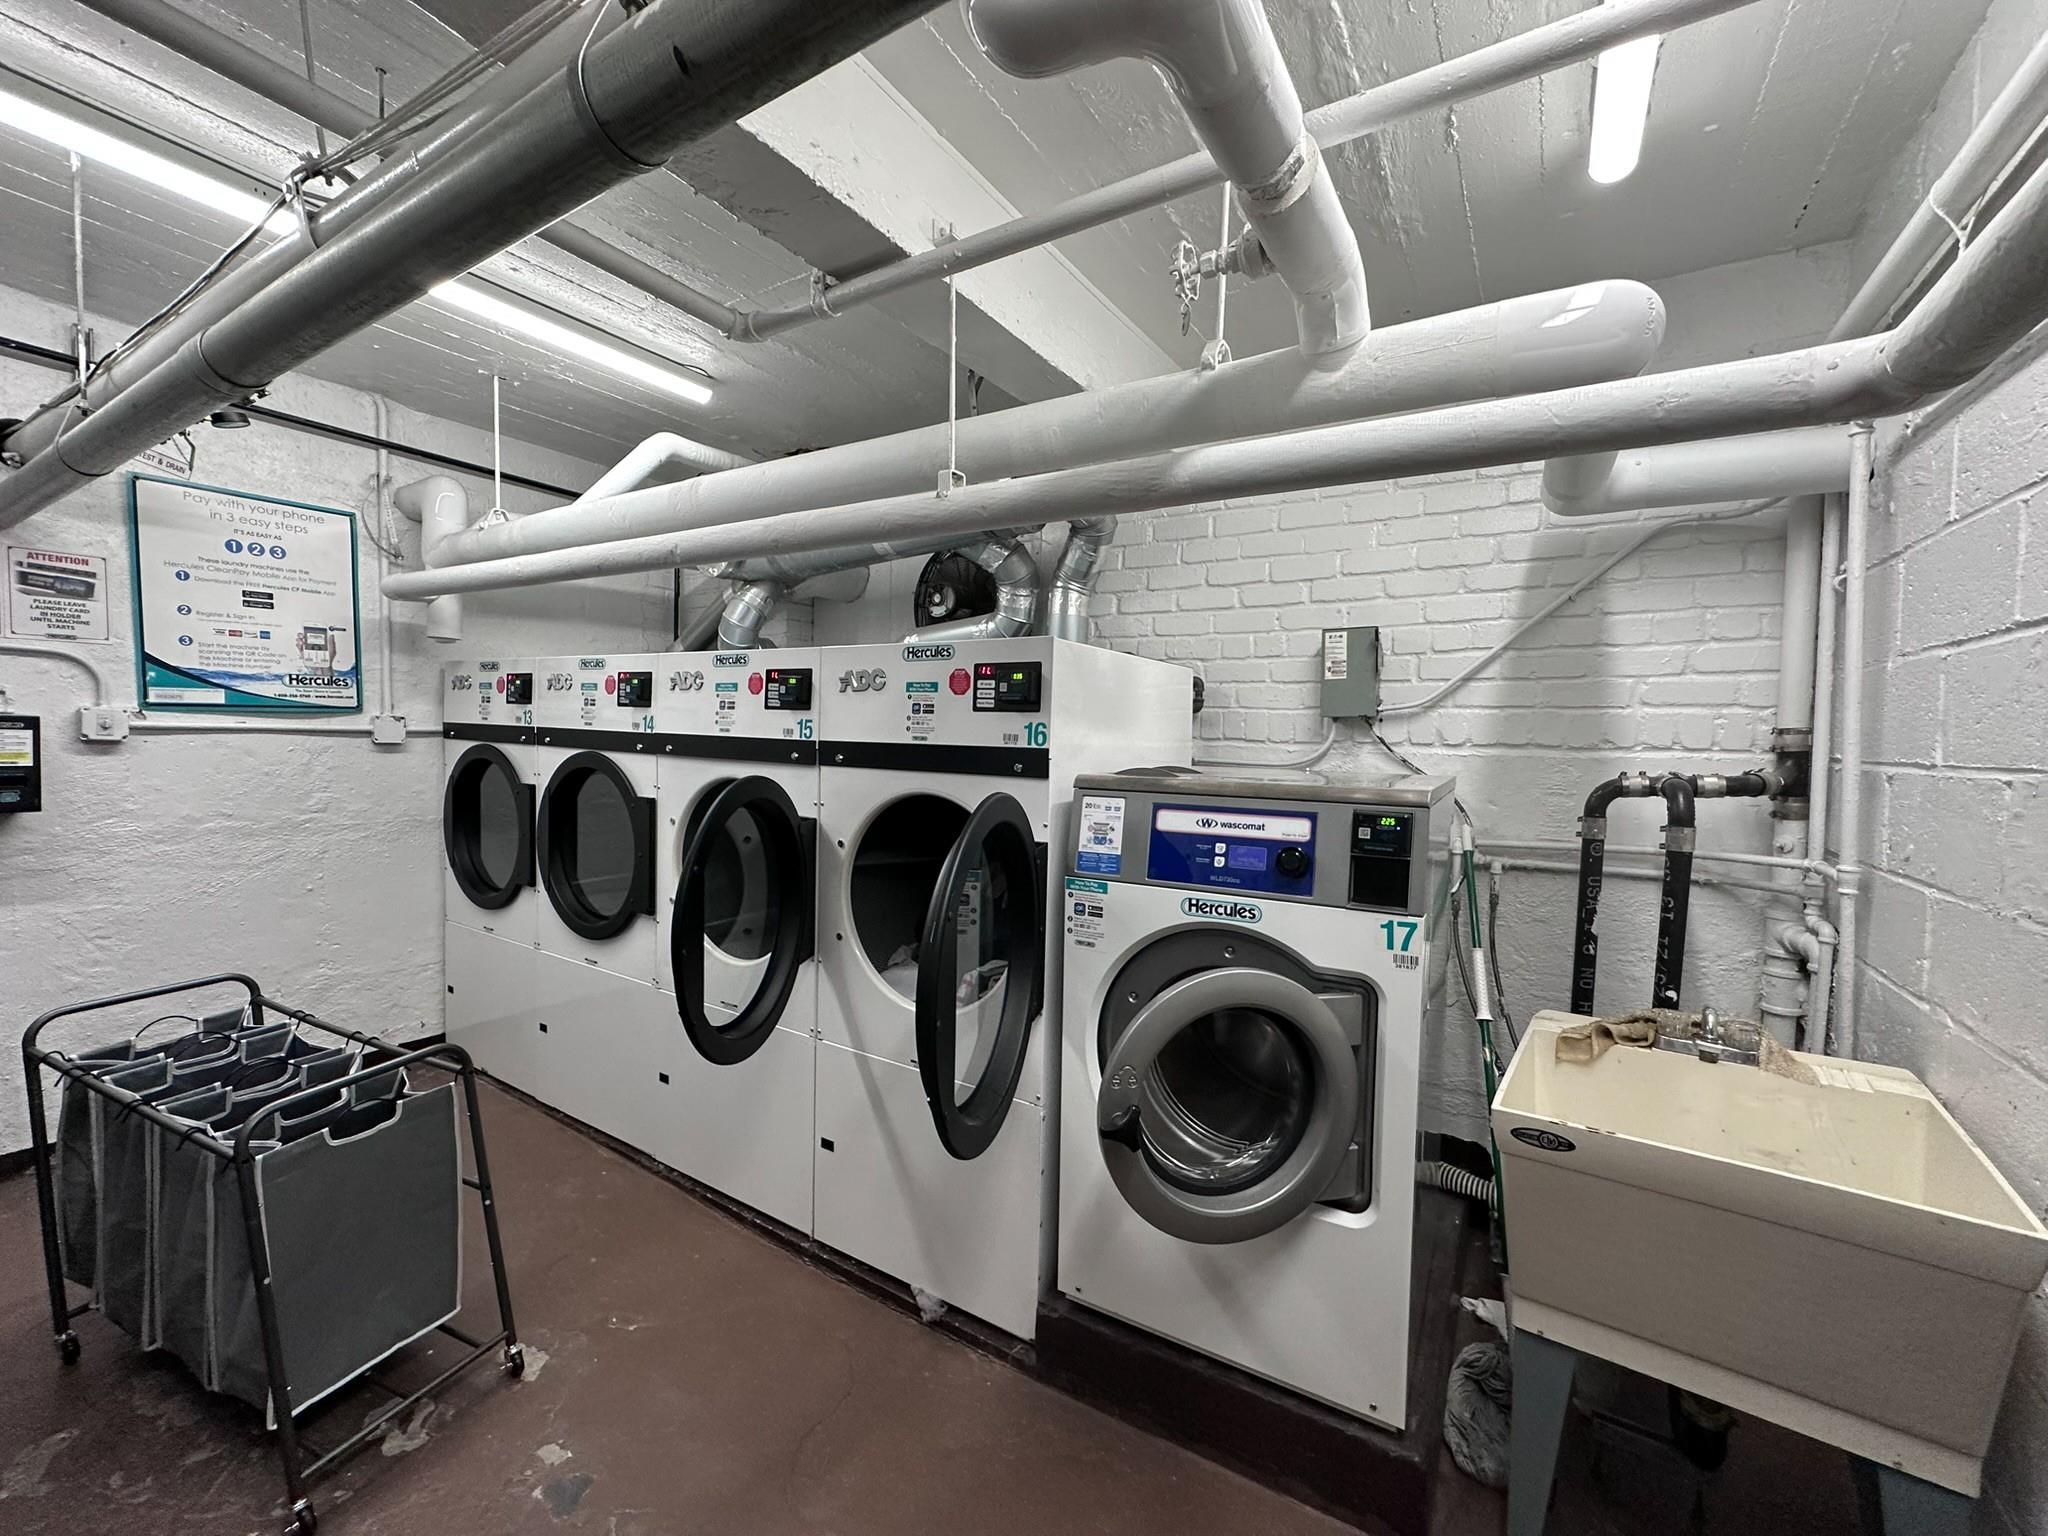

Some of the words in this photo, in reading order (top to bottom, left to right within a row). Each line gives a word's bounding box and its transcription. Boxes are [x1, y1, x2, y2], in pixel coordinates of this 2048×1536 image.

[166, 461, 186, 474] DRAIN
[184, 491, 210, 506] Pay
[216, 498, 245, 512] with
[249, 504, 279, 516] your
[282, 510, 325, 524] phone
[209, 510, 222, 520] in
[226, 512, 234, 522] 3
[239, 516, 271, 530] easy
[275, 521, 308, 534] steps
[26, 551, 89, 566] ATTENTION
[30, 604, 67, 612] LAUNDRY
[64, 600, 86, 608] LEAVE
[56, 618, 90, 626] MACHINE
[715, 654, 747, 665] Hercules
[906, 646, 952, 660] Hercules
[288, 674, 350, 687] Hercules
[670, 670, 705, 692] ADC
[839, 668, 886, 692] ADC
[523, 710, 533, 725] 13
[642, 714, 655, 733] 14
[797, 718, 813, 739] 15
[1024, 721, 1048, 747] 16
[1220, 821, 1265, 831] wascomat
[1187, 898, 1257, 920] Hercules
[1380, 920, 1418, 952] 17
